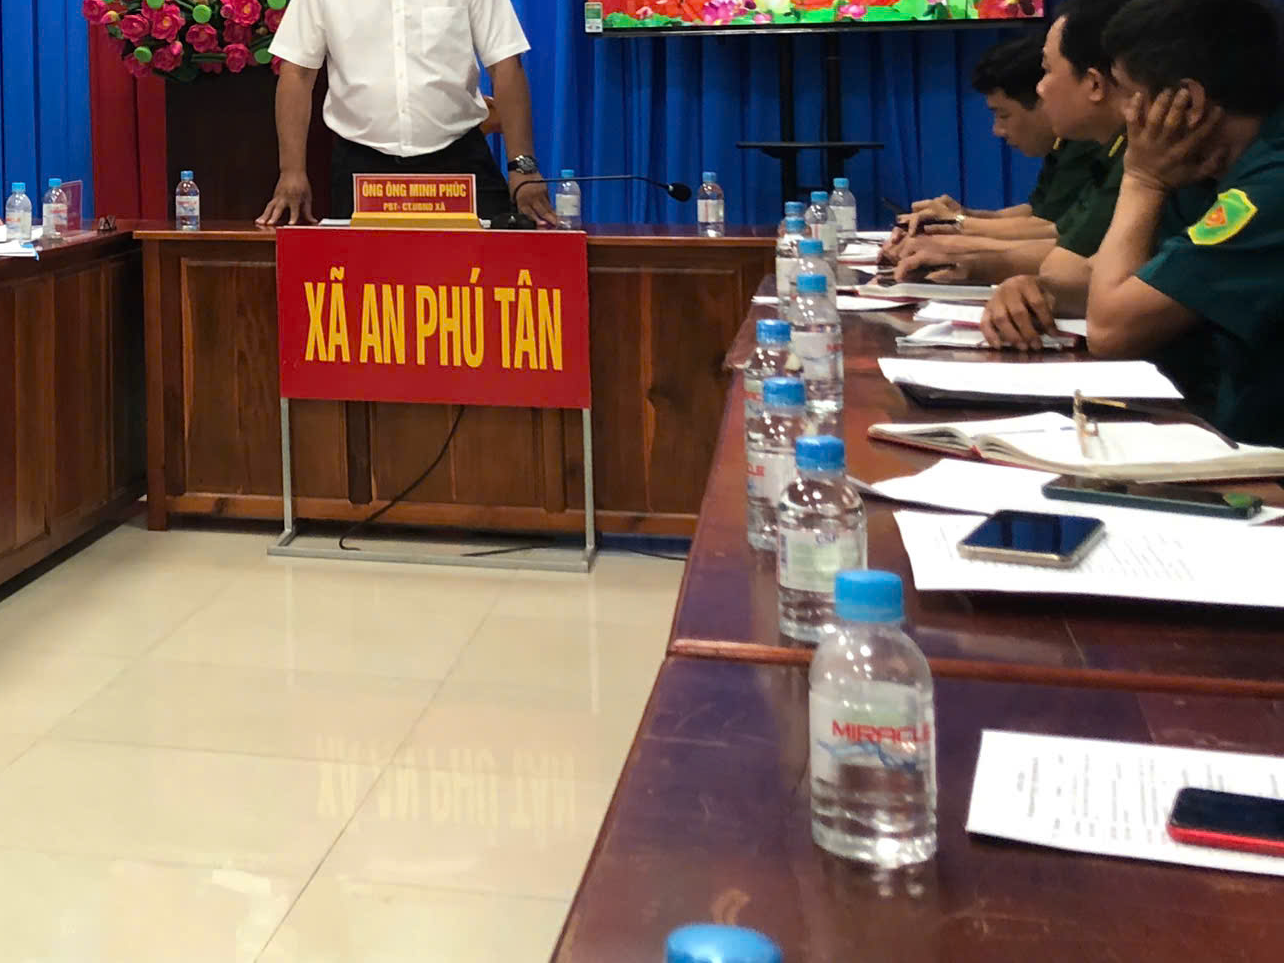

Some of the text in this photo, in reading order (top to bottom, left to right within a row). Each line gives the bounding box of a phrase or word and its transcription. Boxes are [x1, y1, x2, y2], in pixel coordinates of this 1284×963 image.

[362, 181, 383, 197] ÔNG
[409, 184, 436, 197] MINH
[304, 266, 563, 372] XÃ AN PHÚ TÂN
